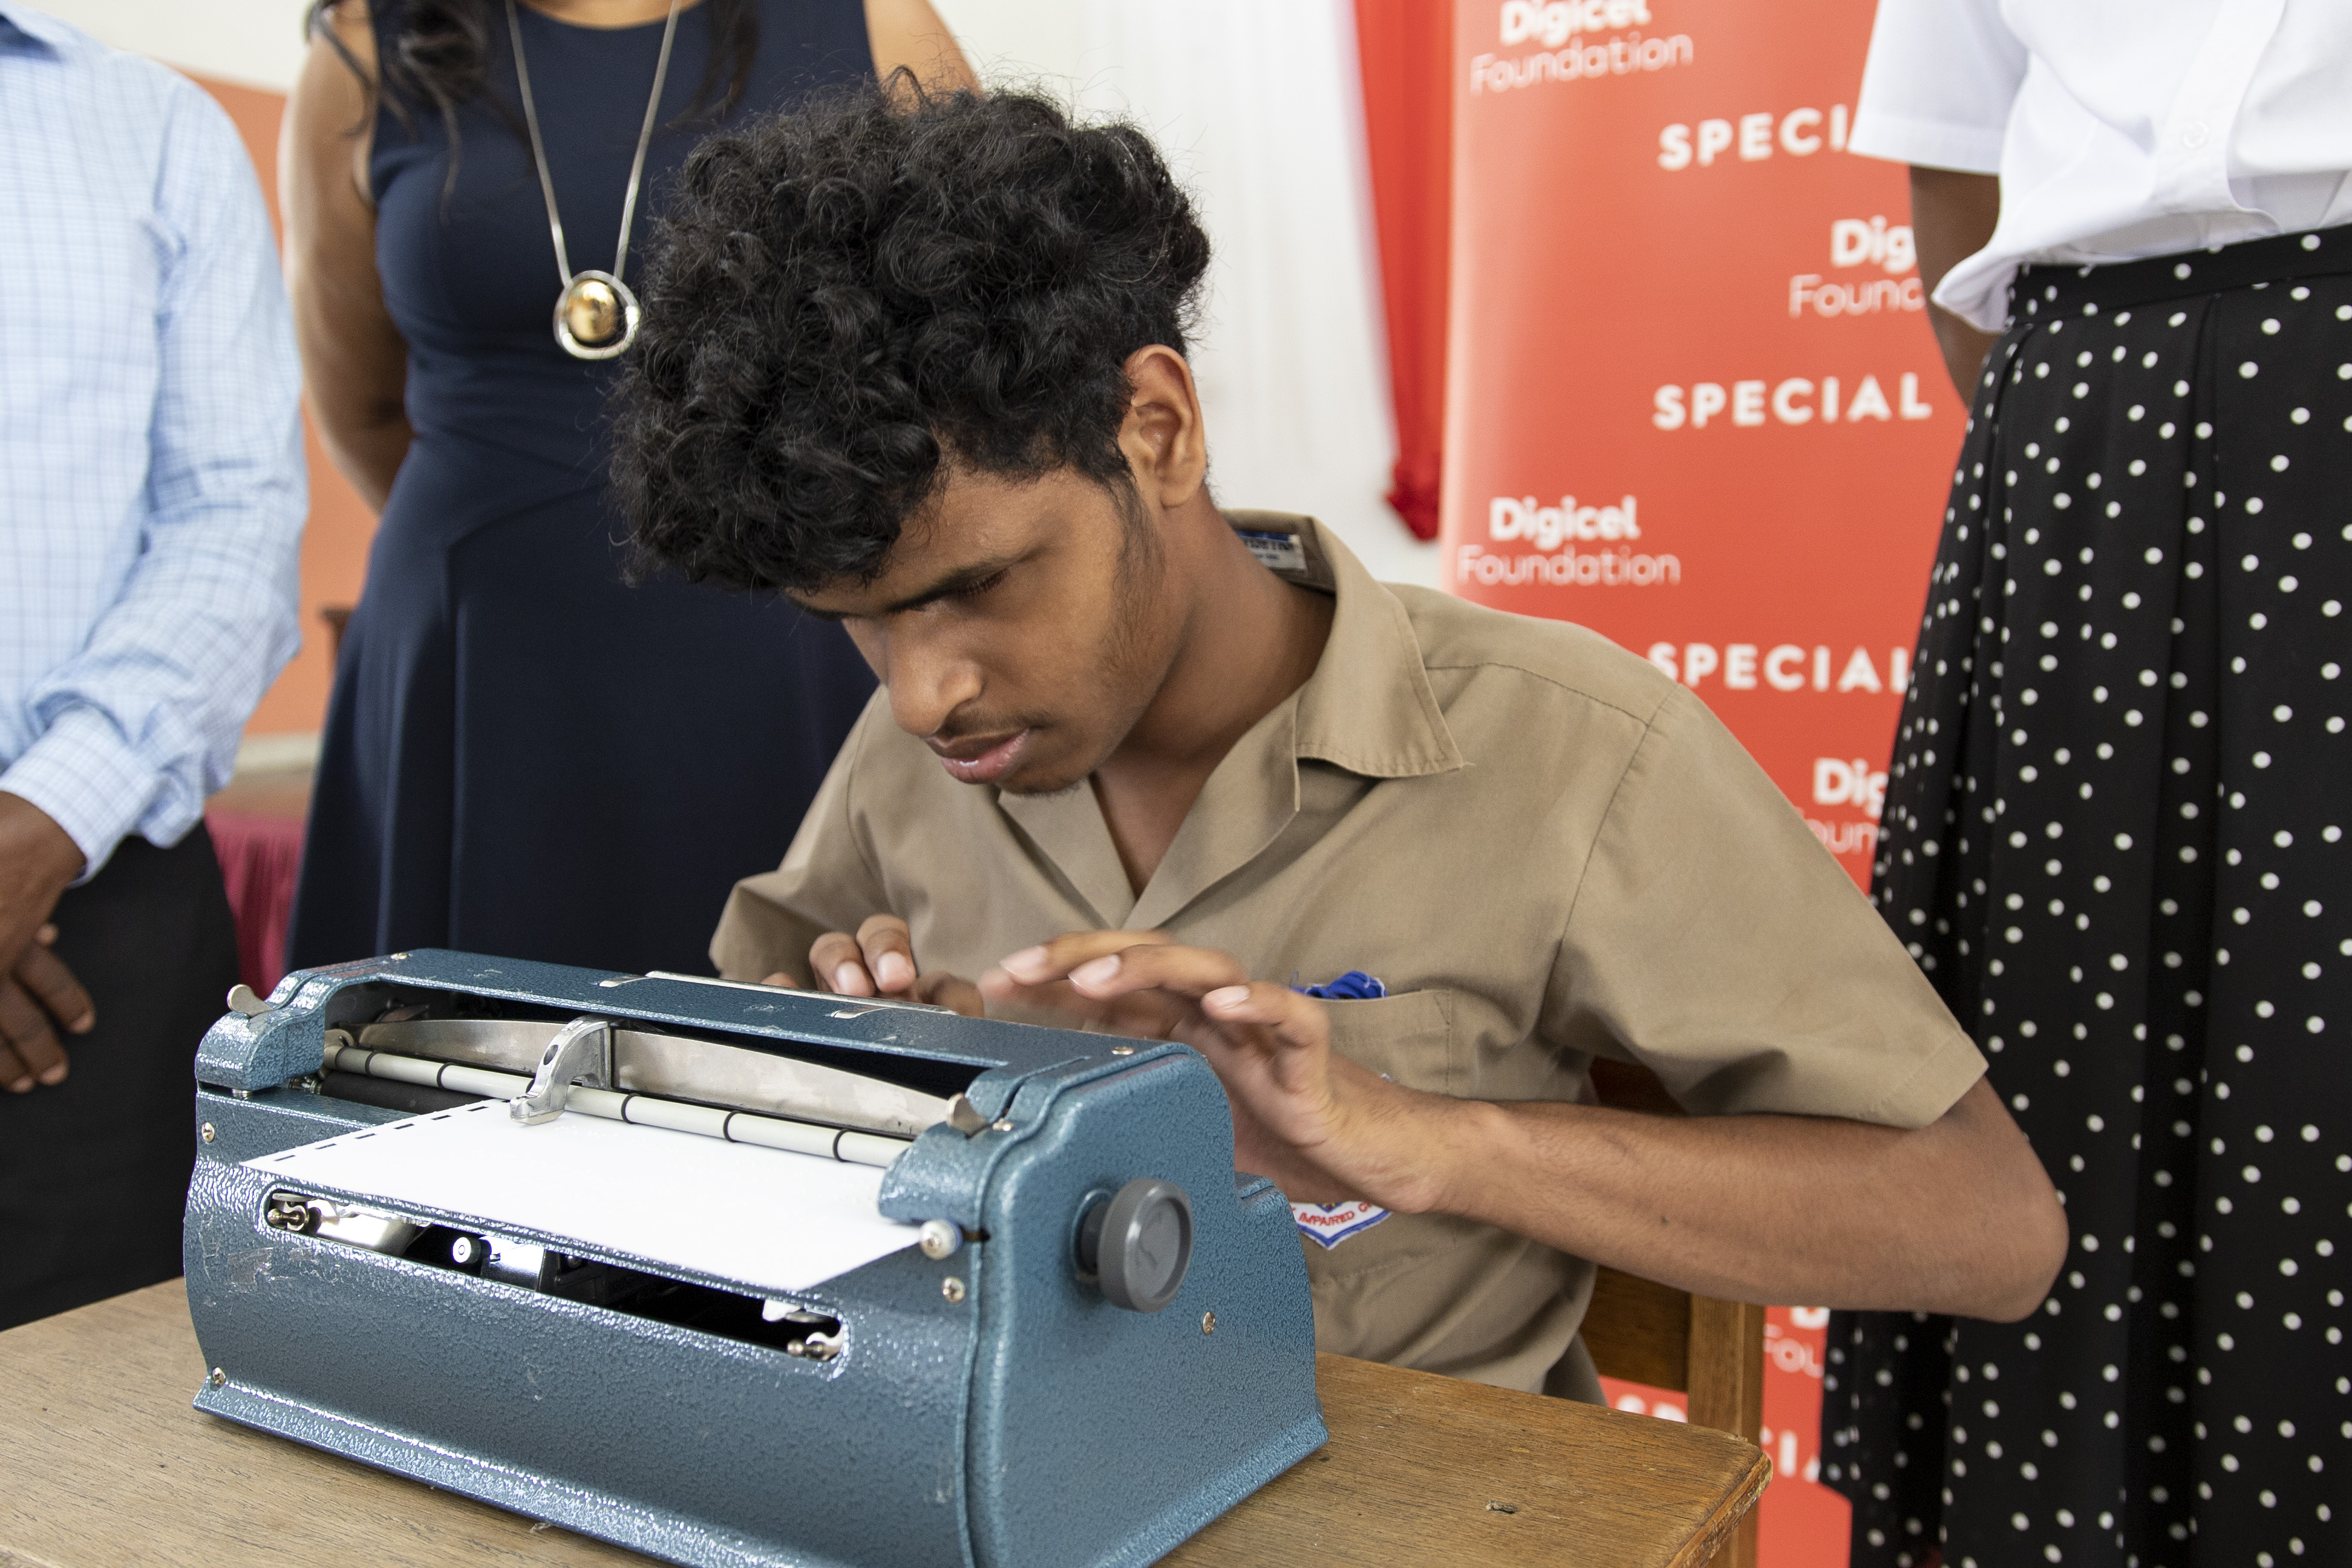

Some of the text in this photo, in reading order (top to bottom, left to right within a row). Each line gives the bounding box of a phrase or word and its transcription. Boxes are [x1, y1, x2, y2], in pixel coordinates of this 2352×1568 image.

[1470, 31, 1693, 95] Foundation
[1653, 372, 1932, 431] SPECIAL
[1489, 495, 1642, 551] Digicel
[1457, 544, 1681, 586] Foundation
[1298, 1210, 1355, 1227] IMPAIRED
